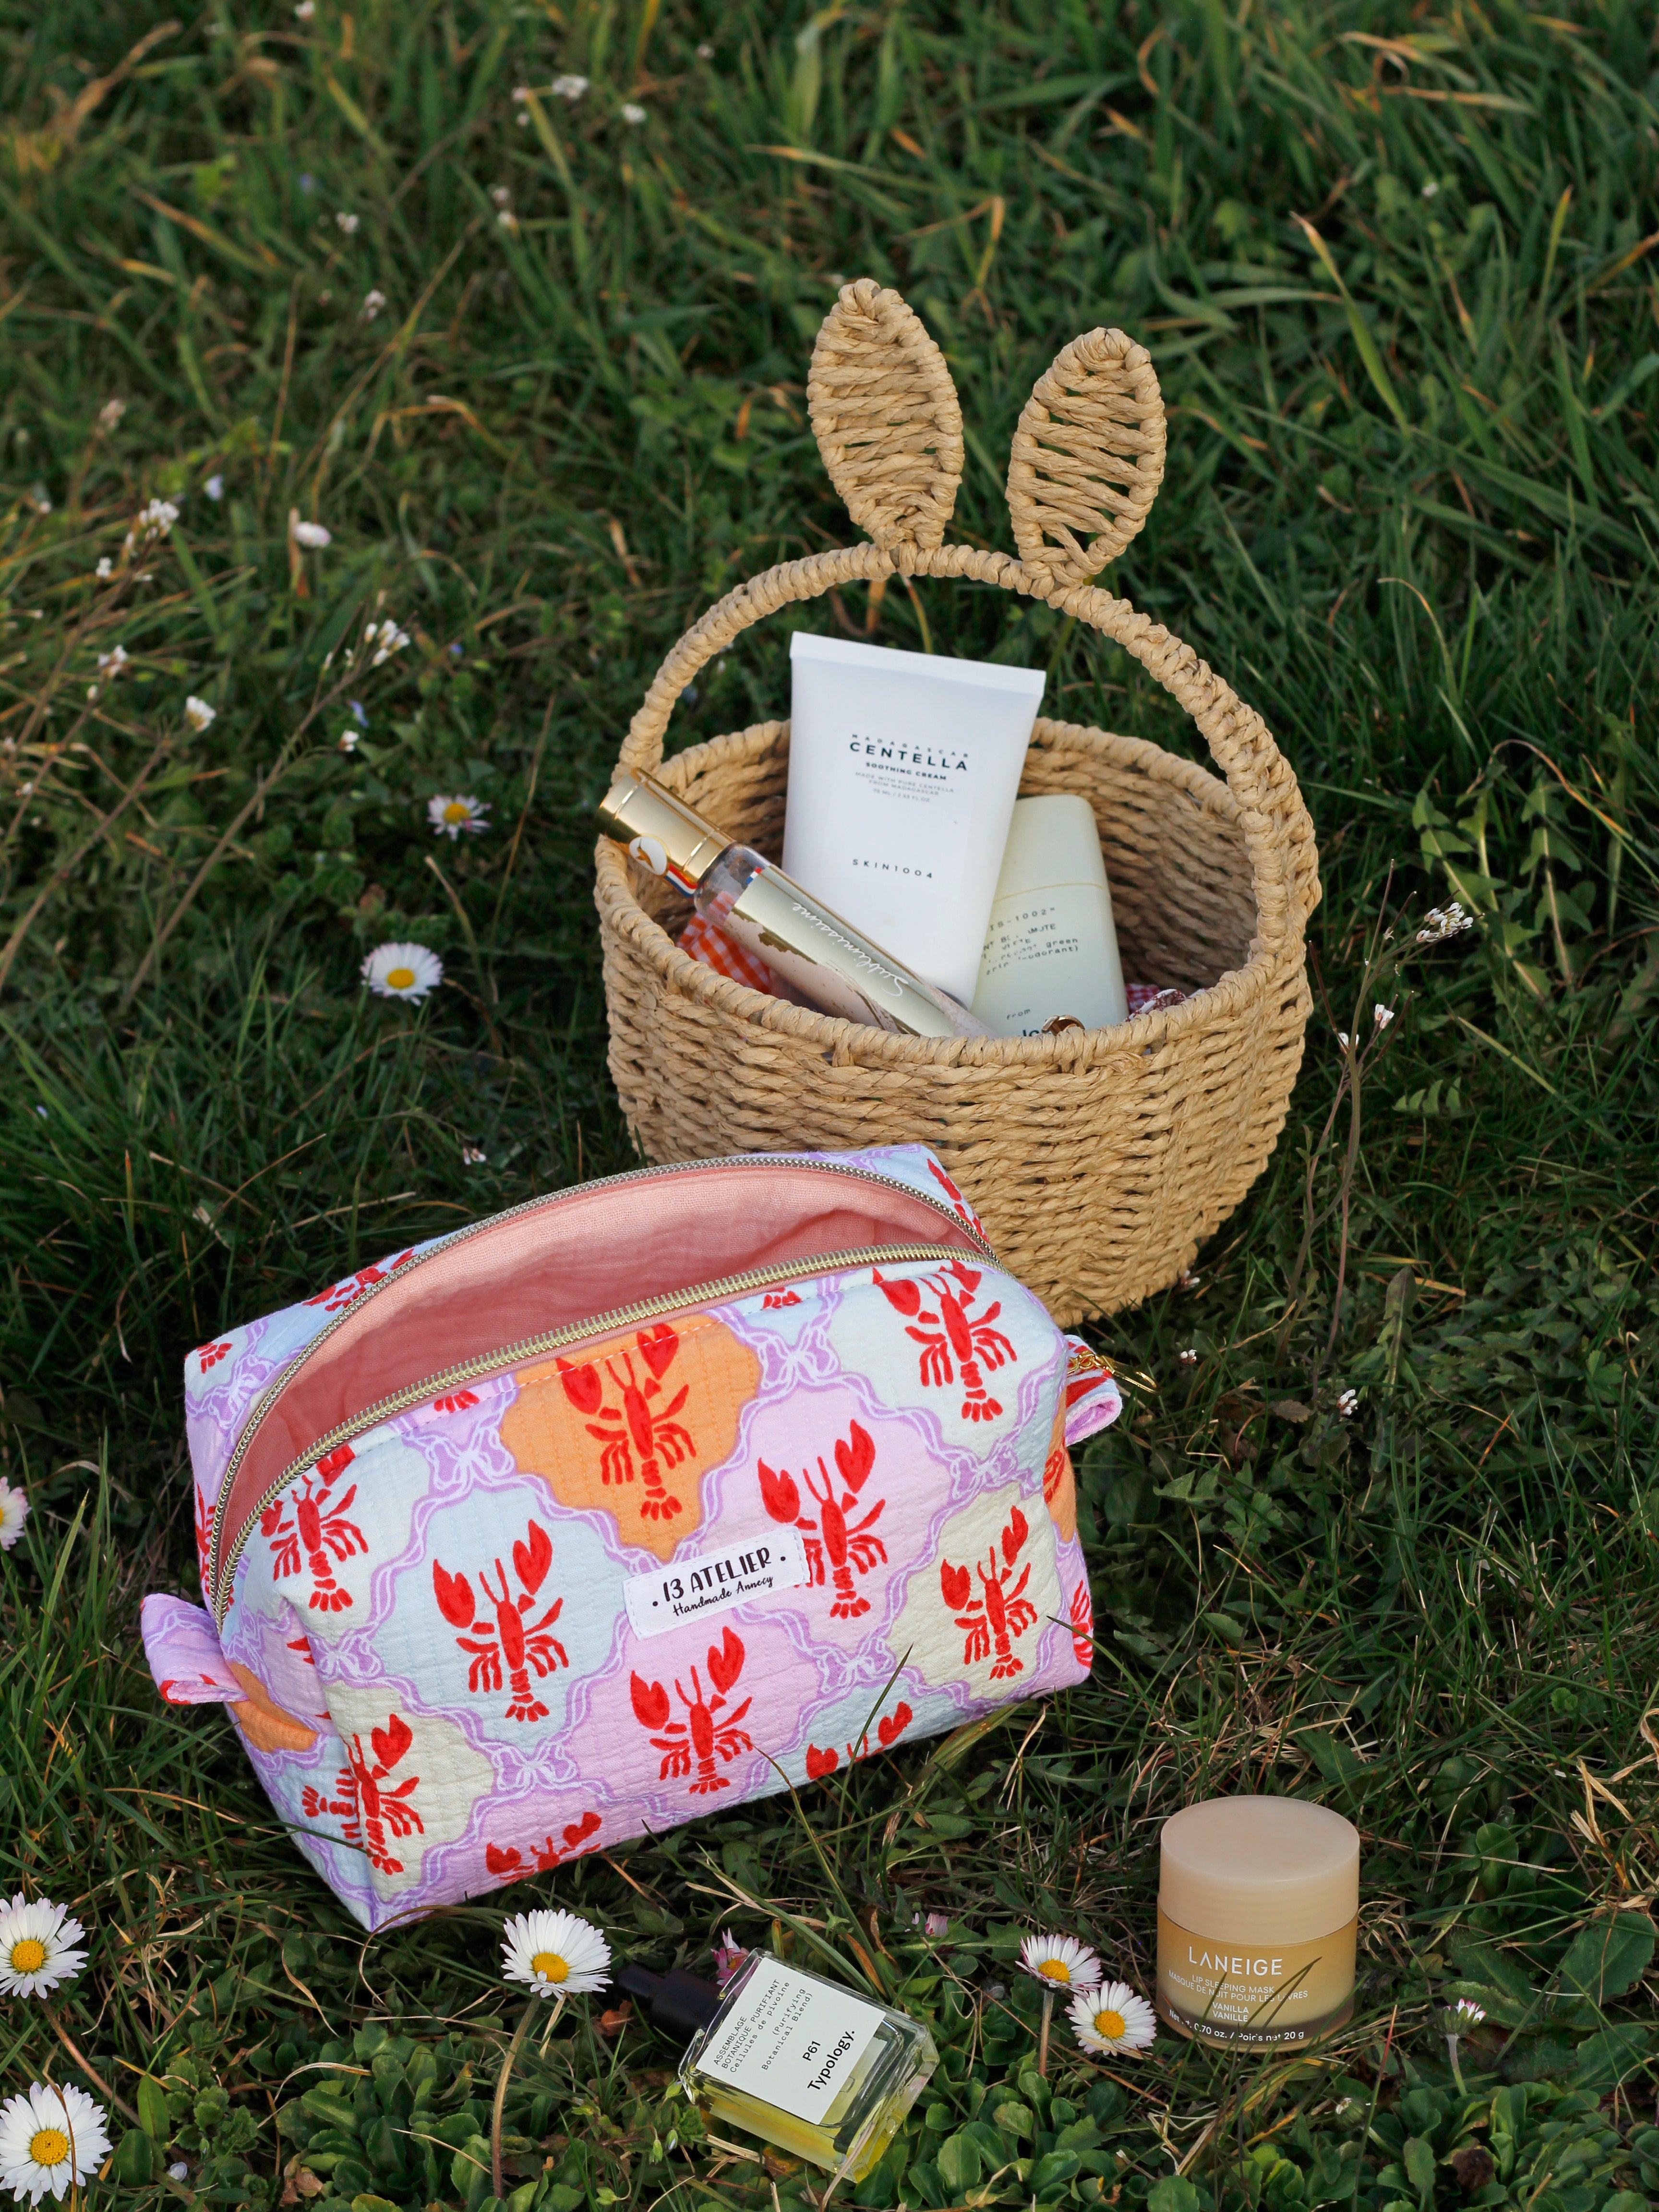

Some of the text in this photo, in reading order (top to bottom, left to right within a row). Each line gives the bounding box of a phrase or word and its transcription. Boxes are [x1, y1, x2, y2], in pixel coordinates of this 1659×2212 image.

[850, 742, 967, 771] CENTELLA
[866, 762, 947, 780] SOOTHING CREAM
[853, 859, 932, 878] SKIN1004
[793, 902, 909, 997] Sublimissime
[1046, 938, 1078, 948] green
[663, 1547, 772, 1601] 13 ATELIER
[673, 1576, 773, 1617] Handmade Annecy
[1189, 1946, 1283, 1976] LANEIGE
[1169, 1970, 1194, 1990] MASQUE
[1197, 1984, 1206, 1994] DE
[1209, 1988, 1228, 1998] NUIT
[1231, 1993, 1256, 2002] POUR
[1192, 1974, 1203, 1984] LIP
[1205, 1979, 1246, 1992] SLEEPING
[772, 1988, 805, 2035] (Purifying
[1213, 2002, 1249, 2014] VANILLA
[1213, 2010, 1248, 2022] VANILLE
[721, 1979, 780, 2069] BOTANIQUE PURIFIANT
[730, 1982, 789, 2073] Cellules de pivoine
[761, 1993, 813, 2070] Botanical Blend)
[1194, 2023, 1212, 2034] 0.70
[1284, 2032, 1296, 2040] 20
[1298, 2031, 1304, 2039] g
[714, 2016, 747, 2065] ASSEMBLAGE
[802, 2041, 821, 2061] P61
[807, 2031, 854, 2090] Typology.
